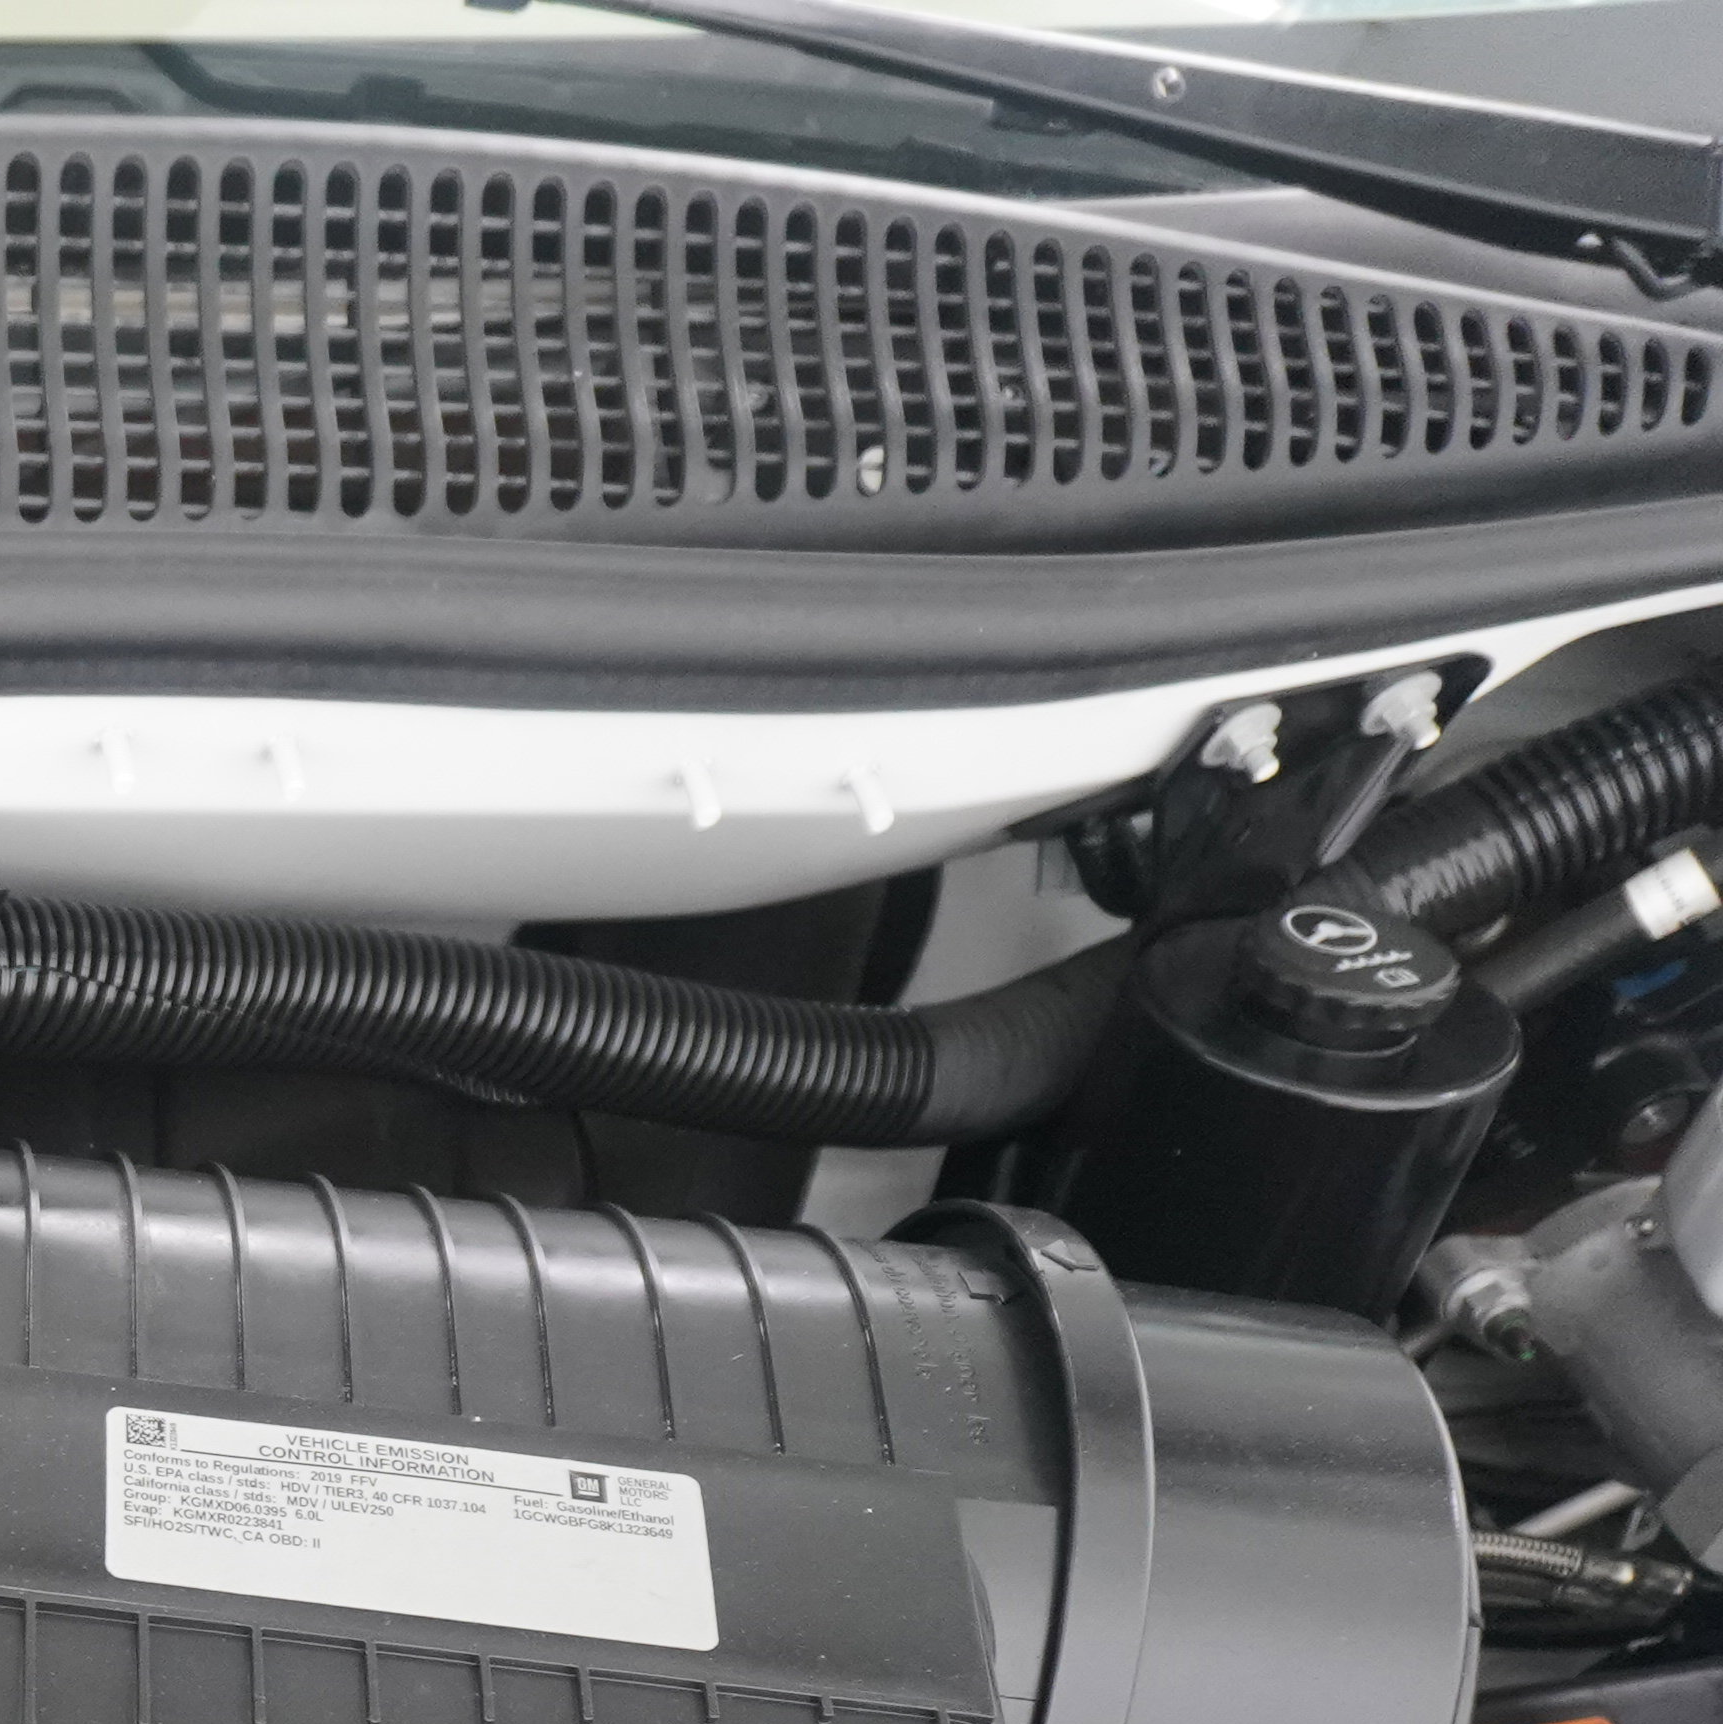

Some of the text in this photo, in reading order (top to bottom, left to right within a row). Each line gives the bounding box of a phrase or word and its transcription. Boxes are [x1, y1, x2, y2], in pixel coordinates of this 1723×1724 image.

[258, 1445, 495, 1483] CONTROL INFORMATION
[286, 1434, 469, 1466] VEHICLE EMISSION
[123, 1449, 378, 1488] Conforms to Regulations: 2019 FFV
[576, 1476, 601, 1492] GM
[617, 1475, 673, 1492] GENERAL
[123, 1462, 151, 1475] U.S.
[155, 1466, 184, 1480] EPA
[188, 1471, 225, 1485] class
[236, 1477, 271, 1490] stds:
[281, 1481, 311, 1495] HDV
[372, 1490, 389, 1503] 40
[392, 1492, 423, 1507] CFR
[427, 1497, 487, 1515] 1037.104
[123, 1475, 191, 1494] California
[193, 1485, 230, 1499] class
[243, 1490, 277, 1504] stds:
[286, 1495, 319, 1509] MDV
[331, 1498, 395, 1518] ULEV250
[123, 1487, 324, 1522] Group: KGMXD06.0395 6.0L
[619, 1485, 670, 1501] MOTORS
[620, 1497, 643, 1508] LLC
[123, 1500, 284, 1531] Evap: KGMXR0223841
[513, 1508, 674, 1540] 1GCWGBFG8K1323649
[514, 1494, 675, 1527] Fuel: Gasoline/Ethanol
[242, 1530, 264, 1543] CA
[269, 1532, 308, 1548] OBD:
[312, 1537, 322, 1550] II
